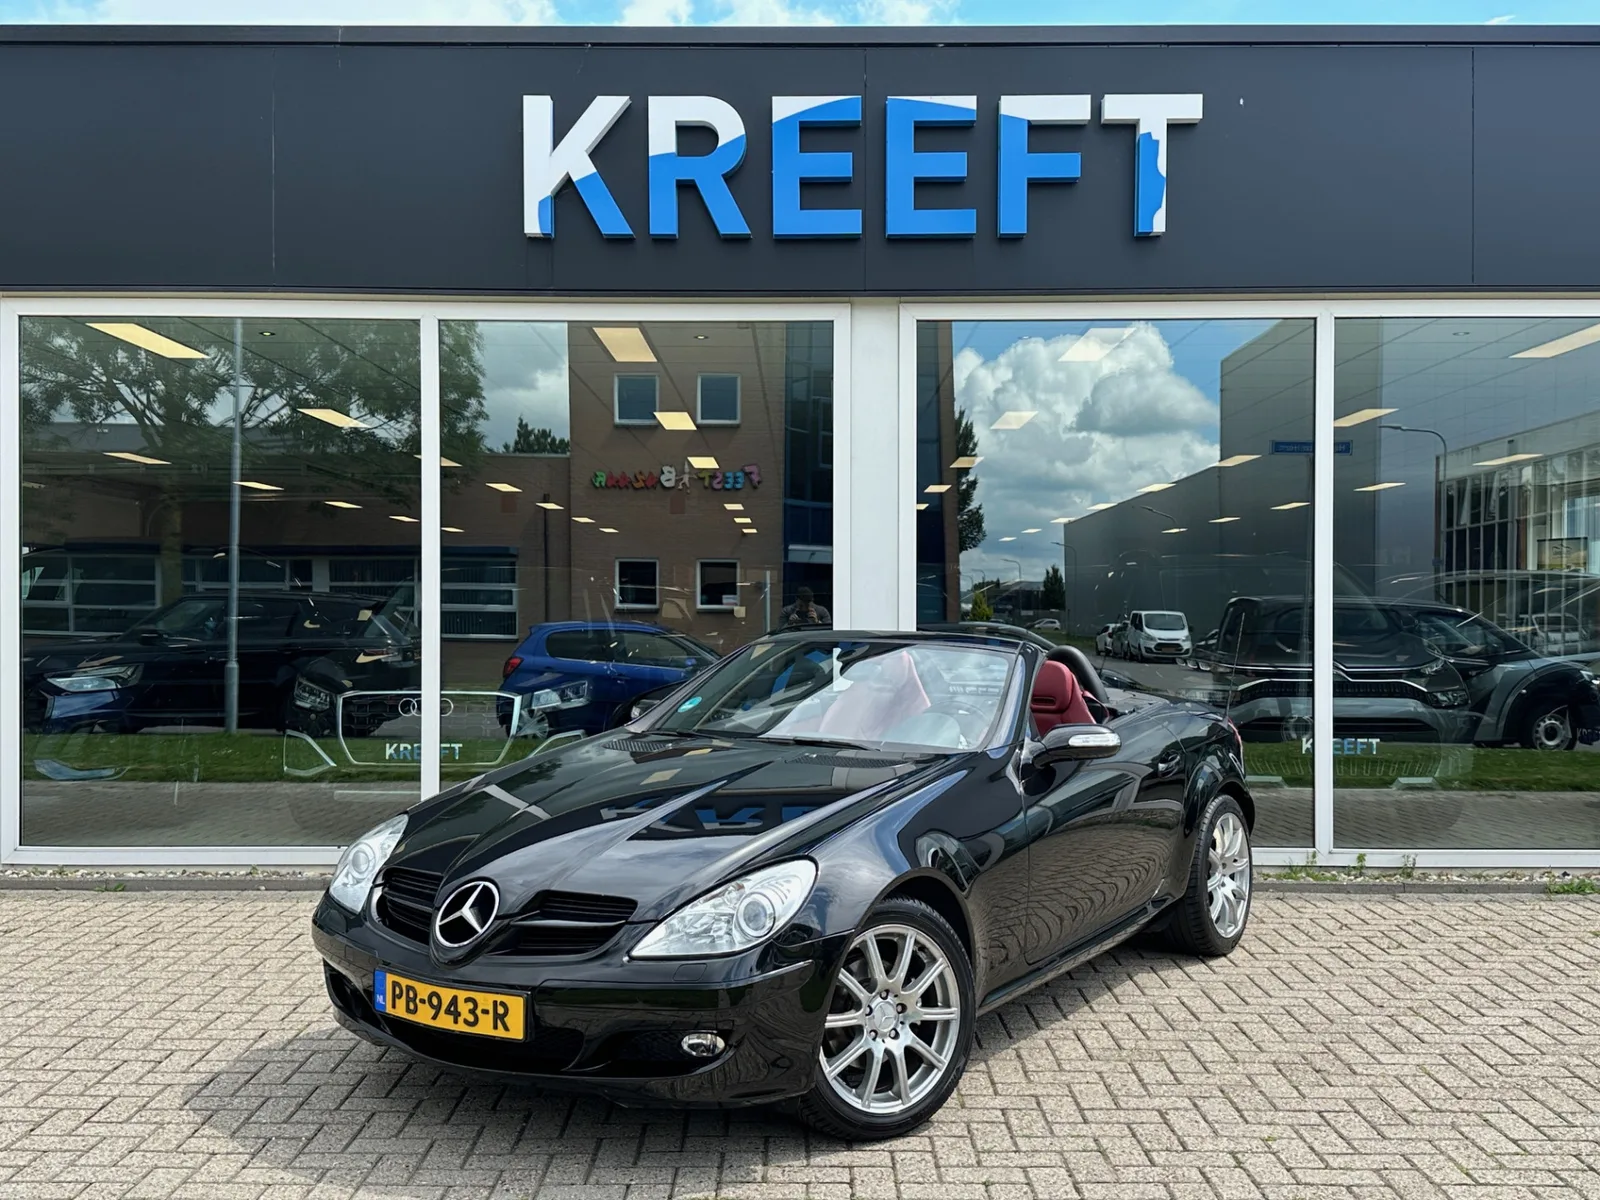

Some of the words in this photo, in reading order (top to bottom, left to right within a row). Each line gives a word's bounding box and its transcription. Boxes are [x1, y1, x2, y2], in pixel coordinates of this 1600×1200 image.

[522, 93, 1204, 239] KREEFT
[385, 743, 463, 760] KREFT
[1301, 738, 1380, 755] KEEFT
[376, 995, 386, 1005] NL
[391, 980, 510, 1032] PB-943-R
